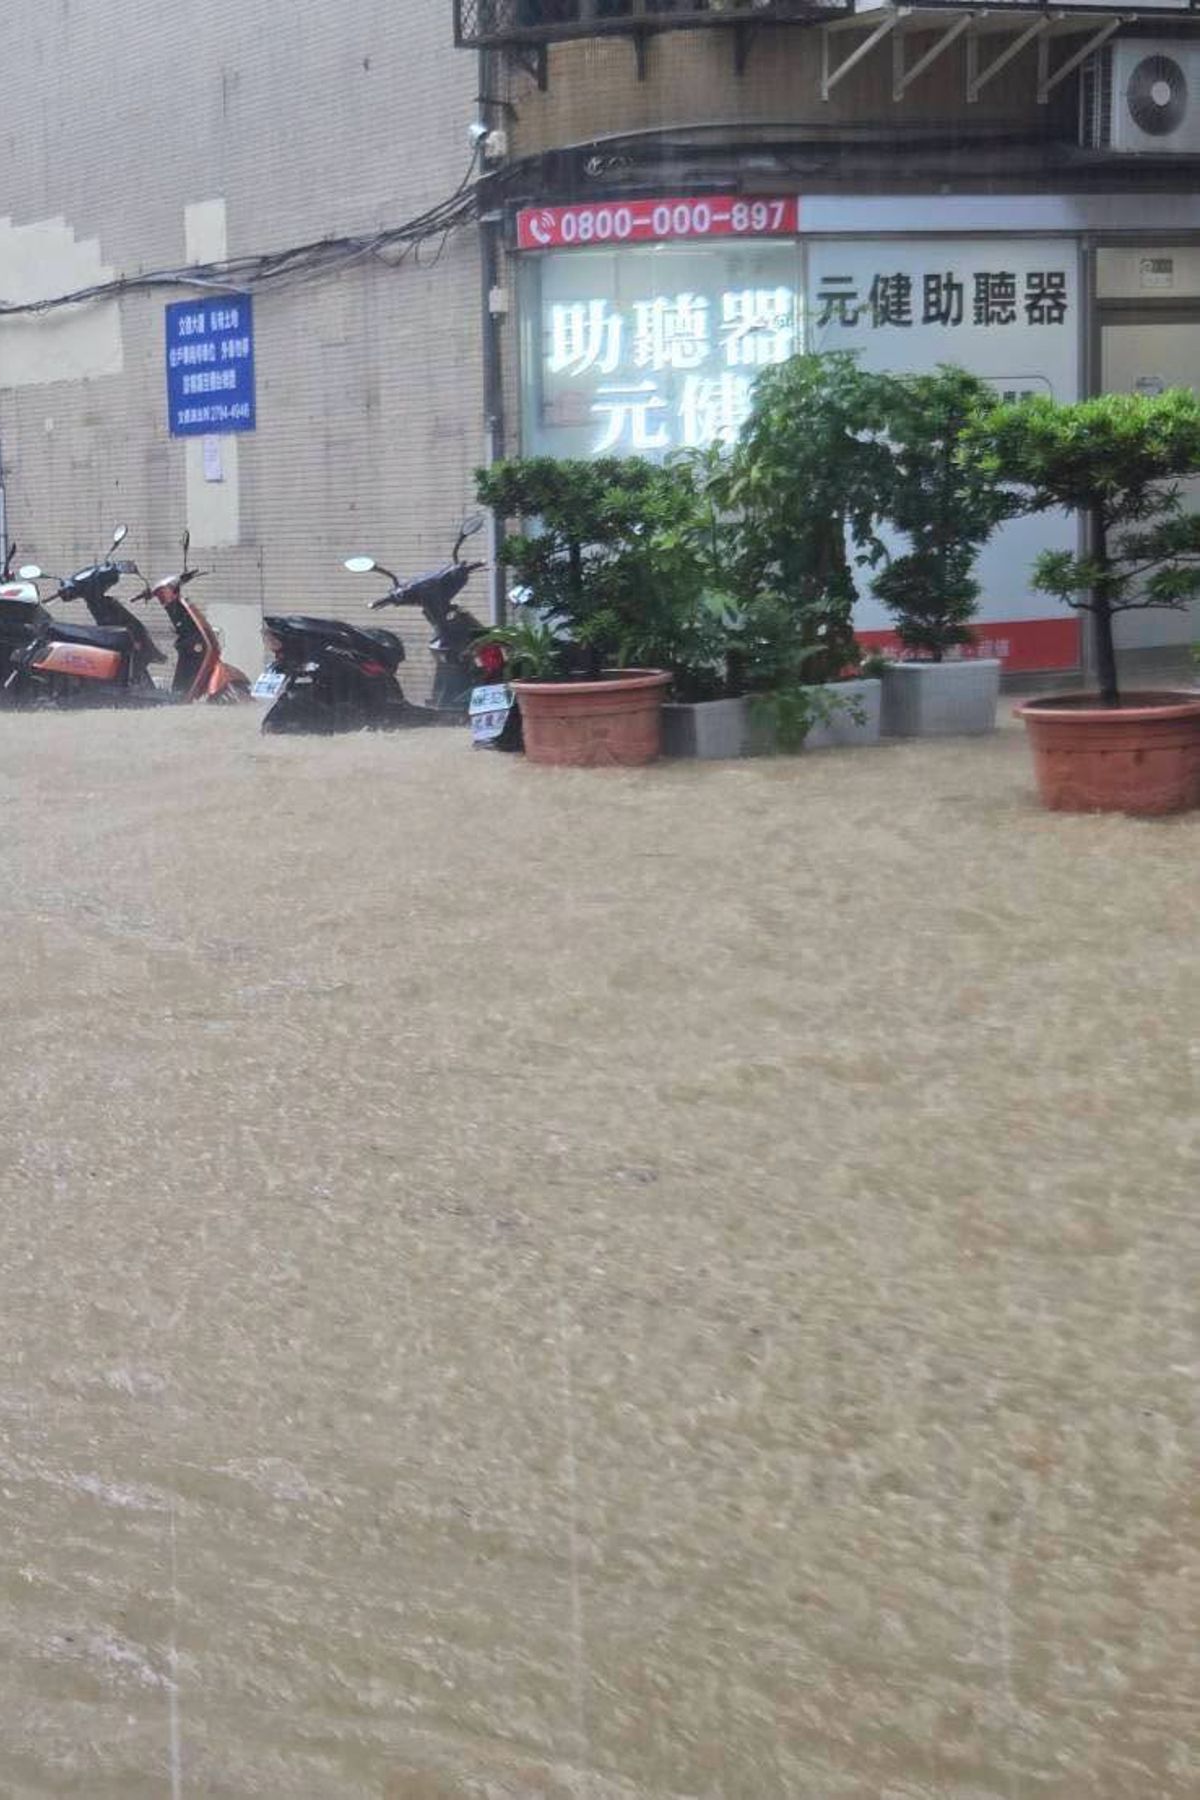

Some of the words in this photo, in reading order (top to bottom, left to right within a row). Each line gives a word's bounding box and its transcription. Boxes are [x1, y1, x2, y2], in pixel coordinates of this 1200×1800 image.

[560, 201, 785, 242] 0800-000-897
[817, 271, 1068, 328] 元健助聽器
[548, 287, 793, 376] 助聽器
